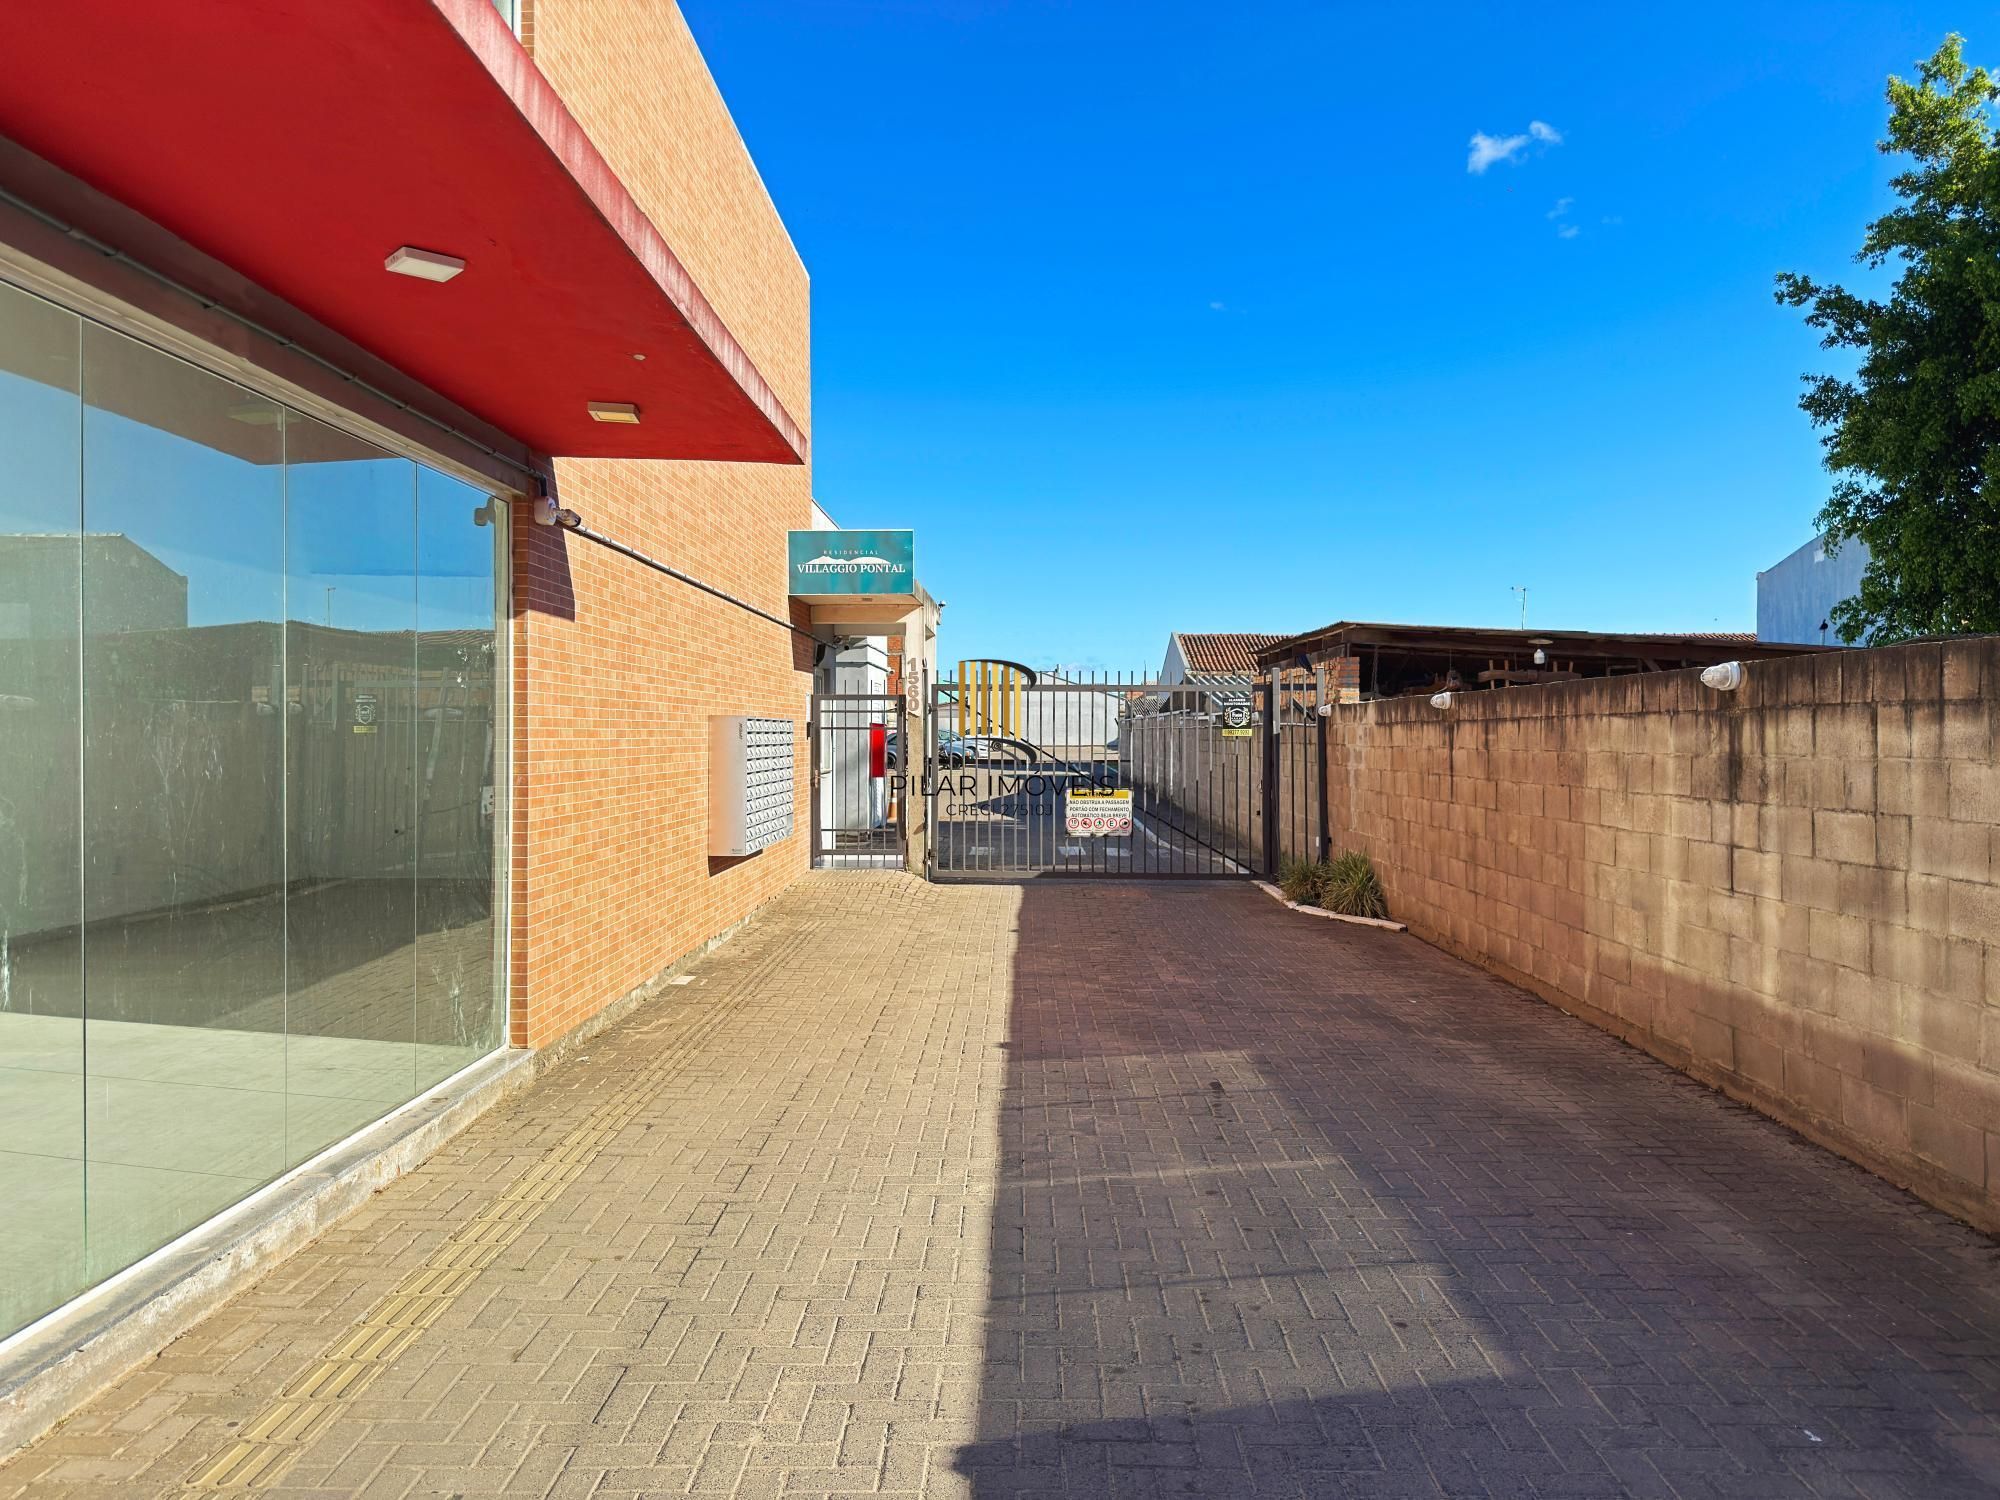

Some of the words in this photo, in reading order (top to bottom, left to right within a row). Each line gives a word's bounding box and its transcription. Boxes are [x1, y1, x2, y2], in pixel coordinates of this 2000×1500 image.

[797, 564, 857, 573] VILLAGGIO
[860, 564, 906, 573] PONTAL
[907, 657, 920, 712] 1560
